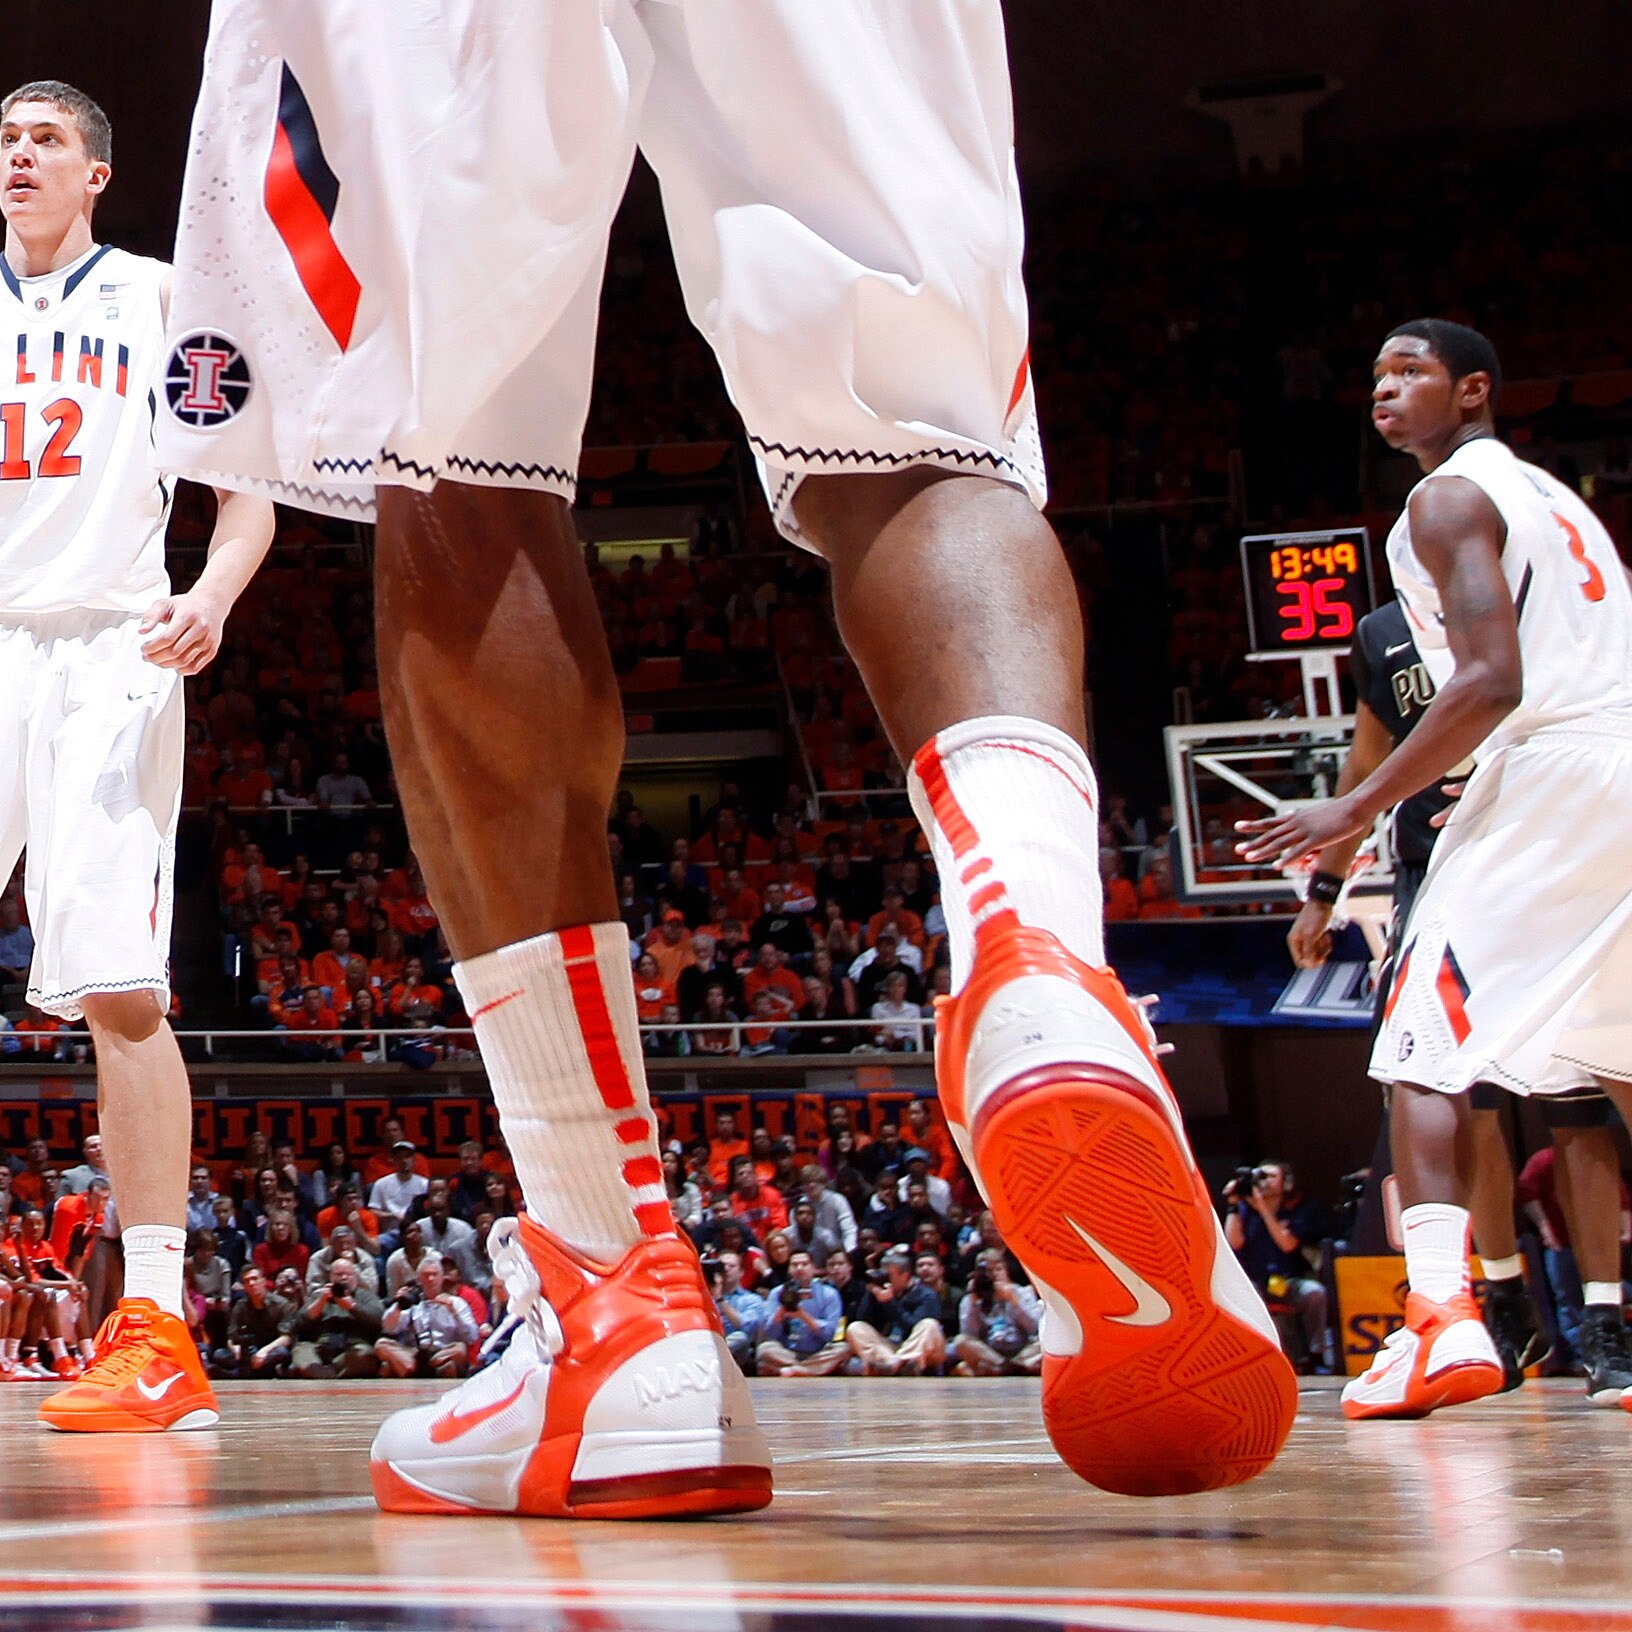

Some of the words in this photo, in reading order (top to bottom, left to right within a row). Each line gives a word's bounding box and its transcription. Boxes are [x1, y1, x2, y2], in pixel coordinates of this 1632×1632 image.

[1270, 542, 1359, 580] 13:49
[1550, 510, 1606, 602] 3
[1275, 577, 1355, 641] 35
[634, 1359, 723, 1407] MAX
